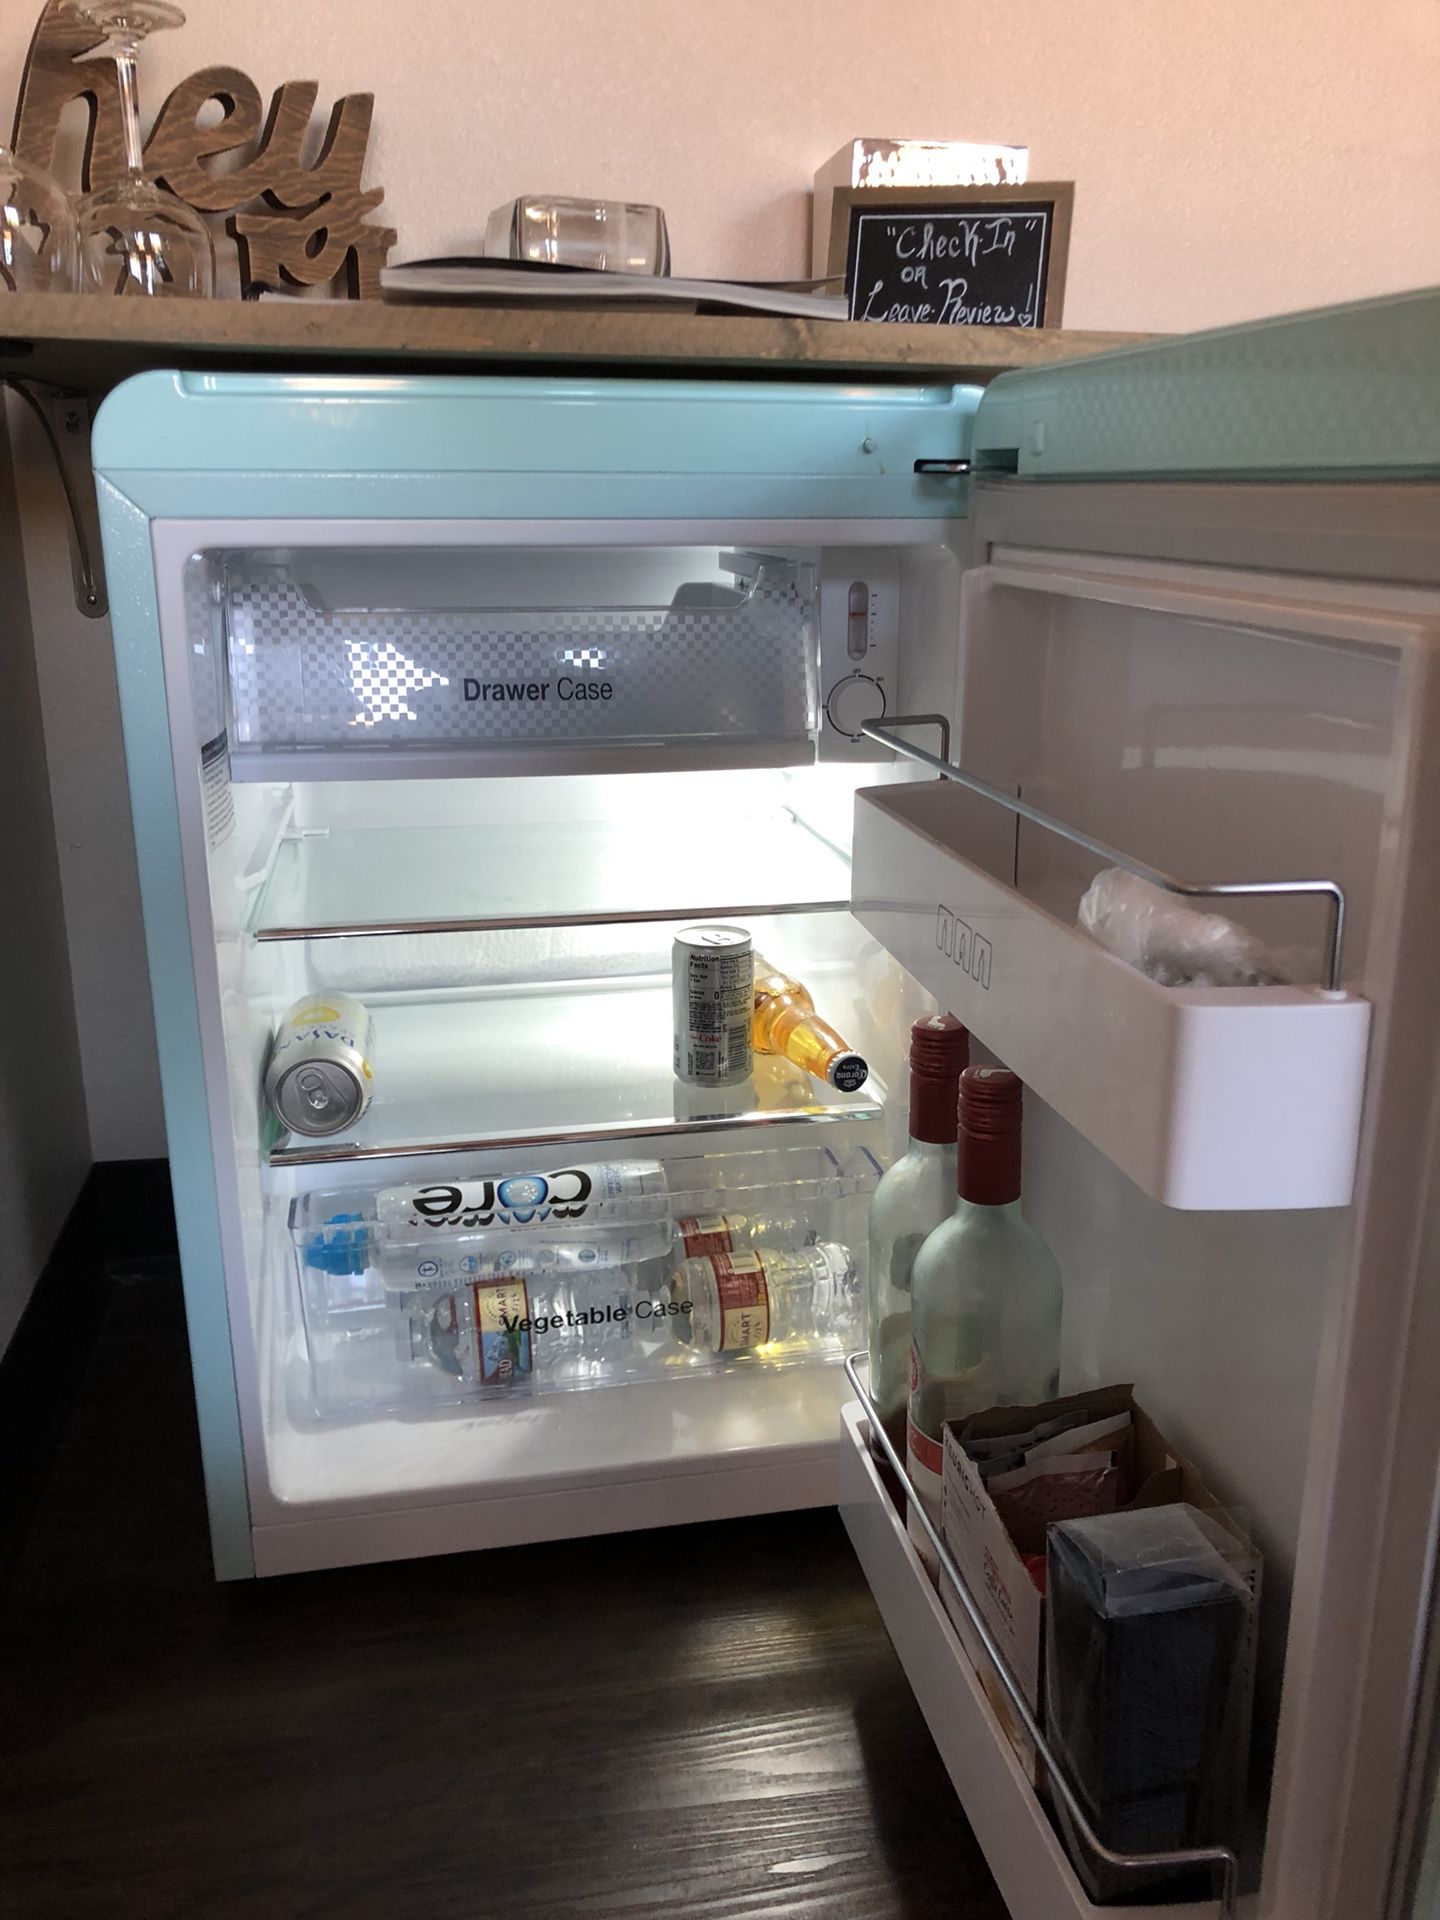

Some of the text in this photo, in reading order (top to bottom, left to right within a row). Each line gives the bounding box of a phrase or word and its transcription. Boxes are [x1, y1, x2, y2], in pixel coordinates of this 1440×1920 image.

[463, 677, 613, 701] Drawer Case
[690, 954, 720, 962] Nutrition
[502, 1305, 627, 1335] Vegetable
[635, 1300, 694, 1319] Case
